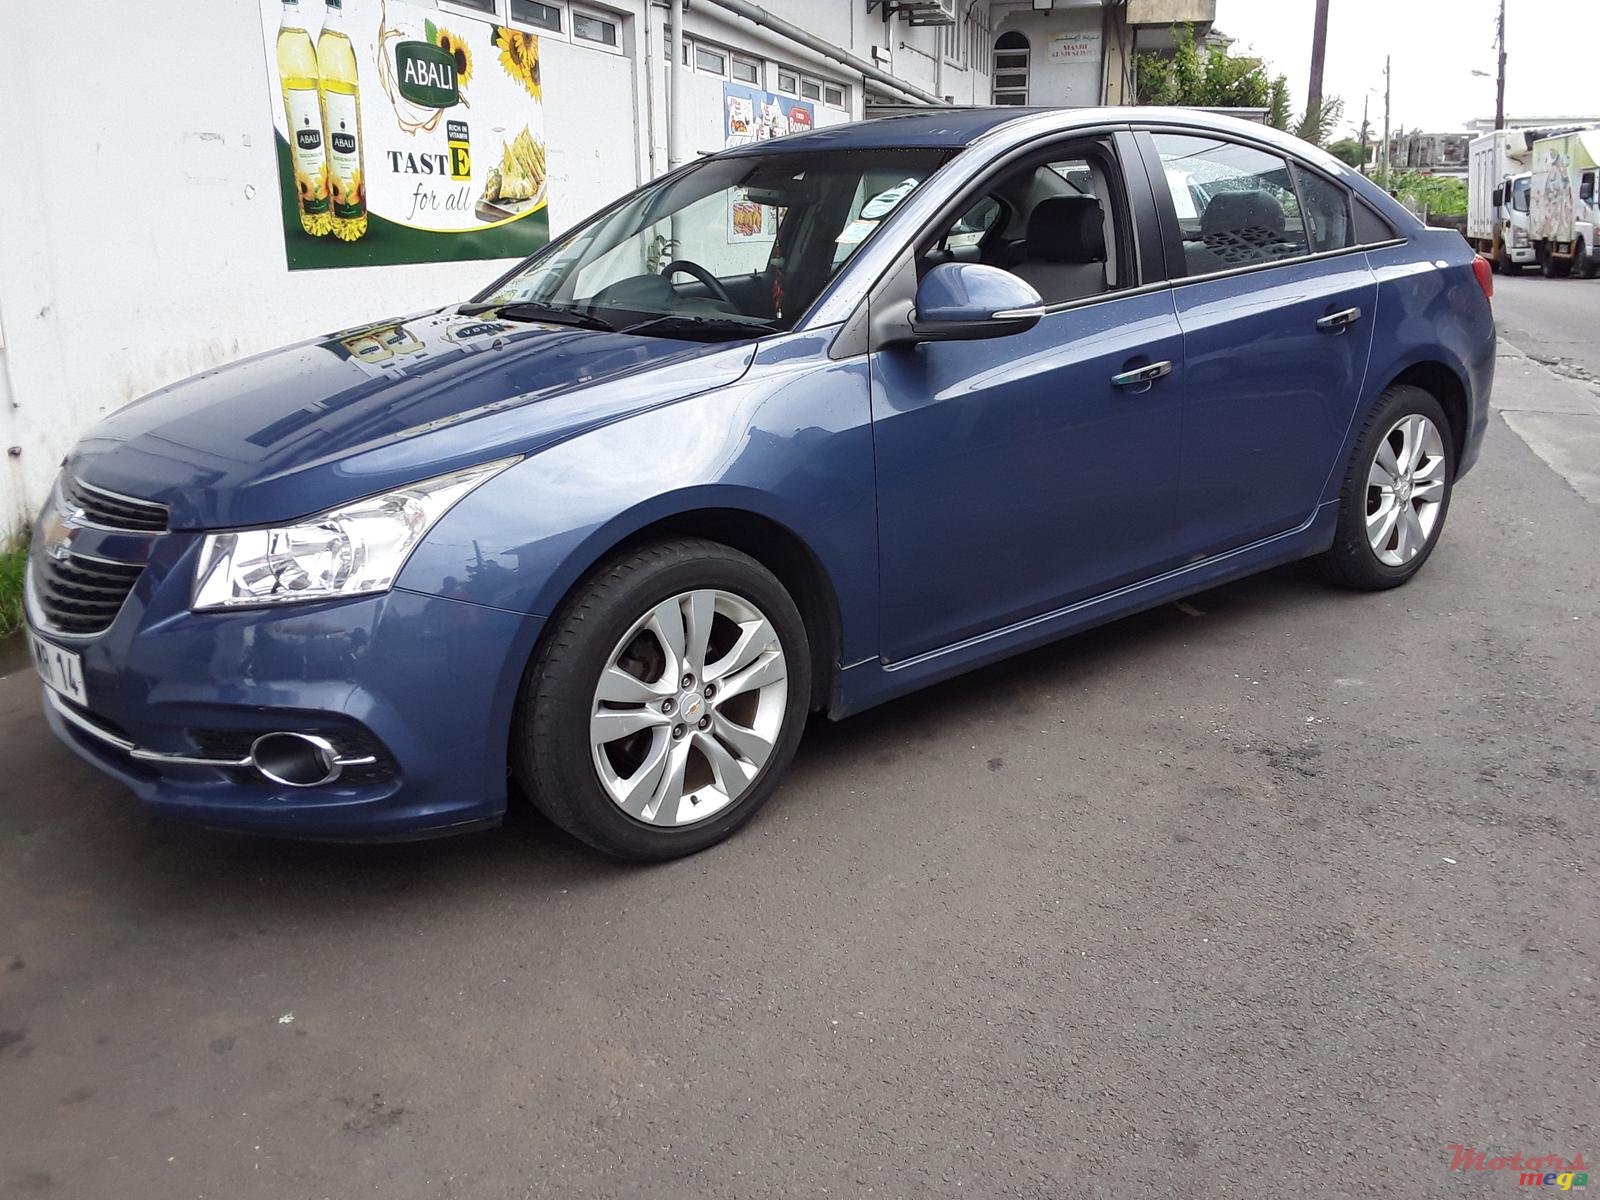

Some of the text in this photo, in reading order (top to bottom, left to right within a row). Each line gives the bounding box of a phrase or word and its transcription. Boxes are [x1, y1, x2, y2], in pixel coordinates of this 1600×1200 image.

[405, 58, 453, 90] ABALI
[299, 134, 320, 143] ABALI
[334, 138, 354, 147] ABALI
[449, 131, 468, 139] VITAMIN
[386, 147, 471, 177] TASTE
[406, 182, 472, 221] for all
[56, 653, 79, 697] 14
